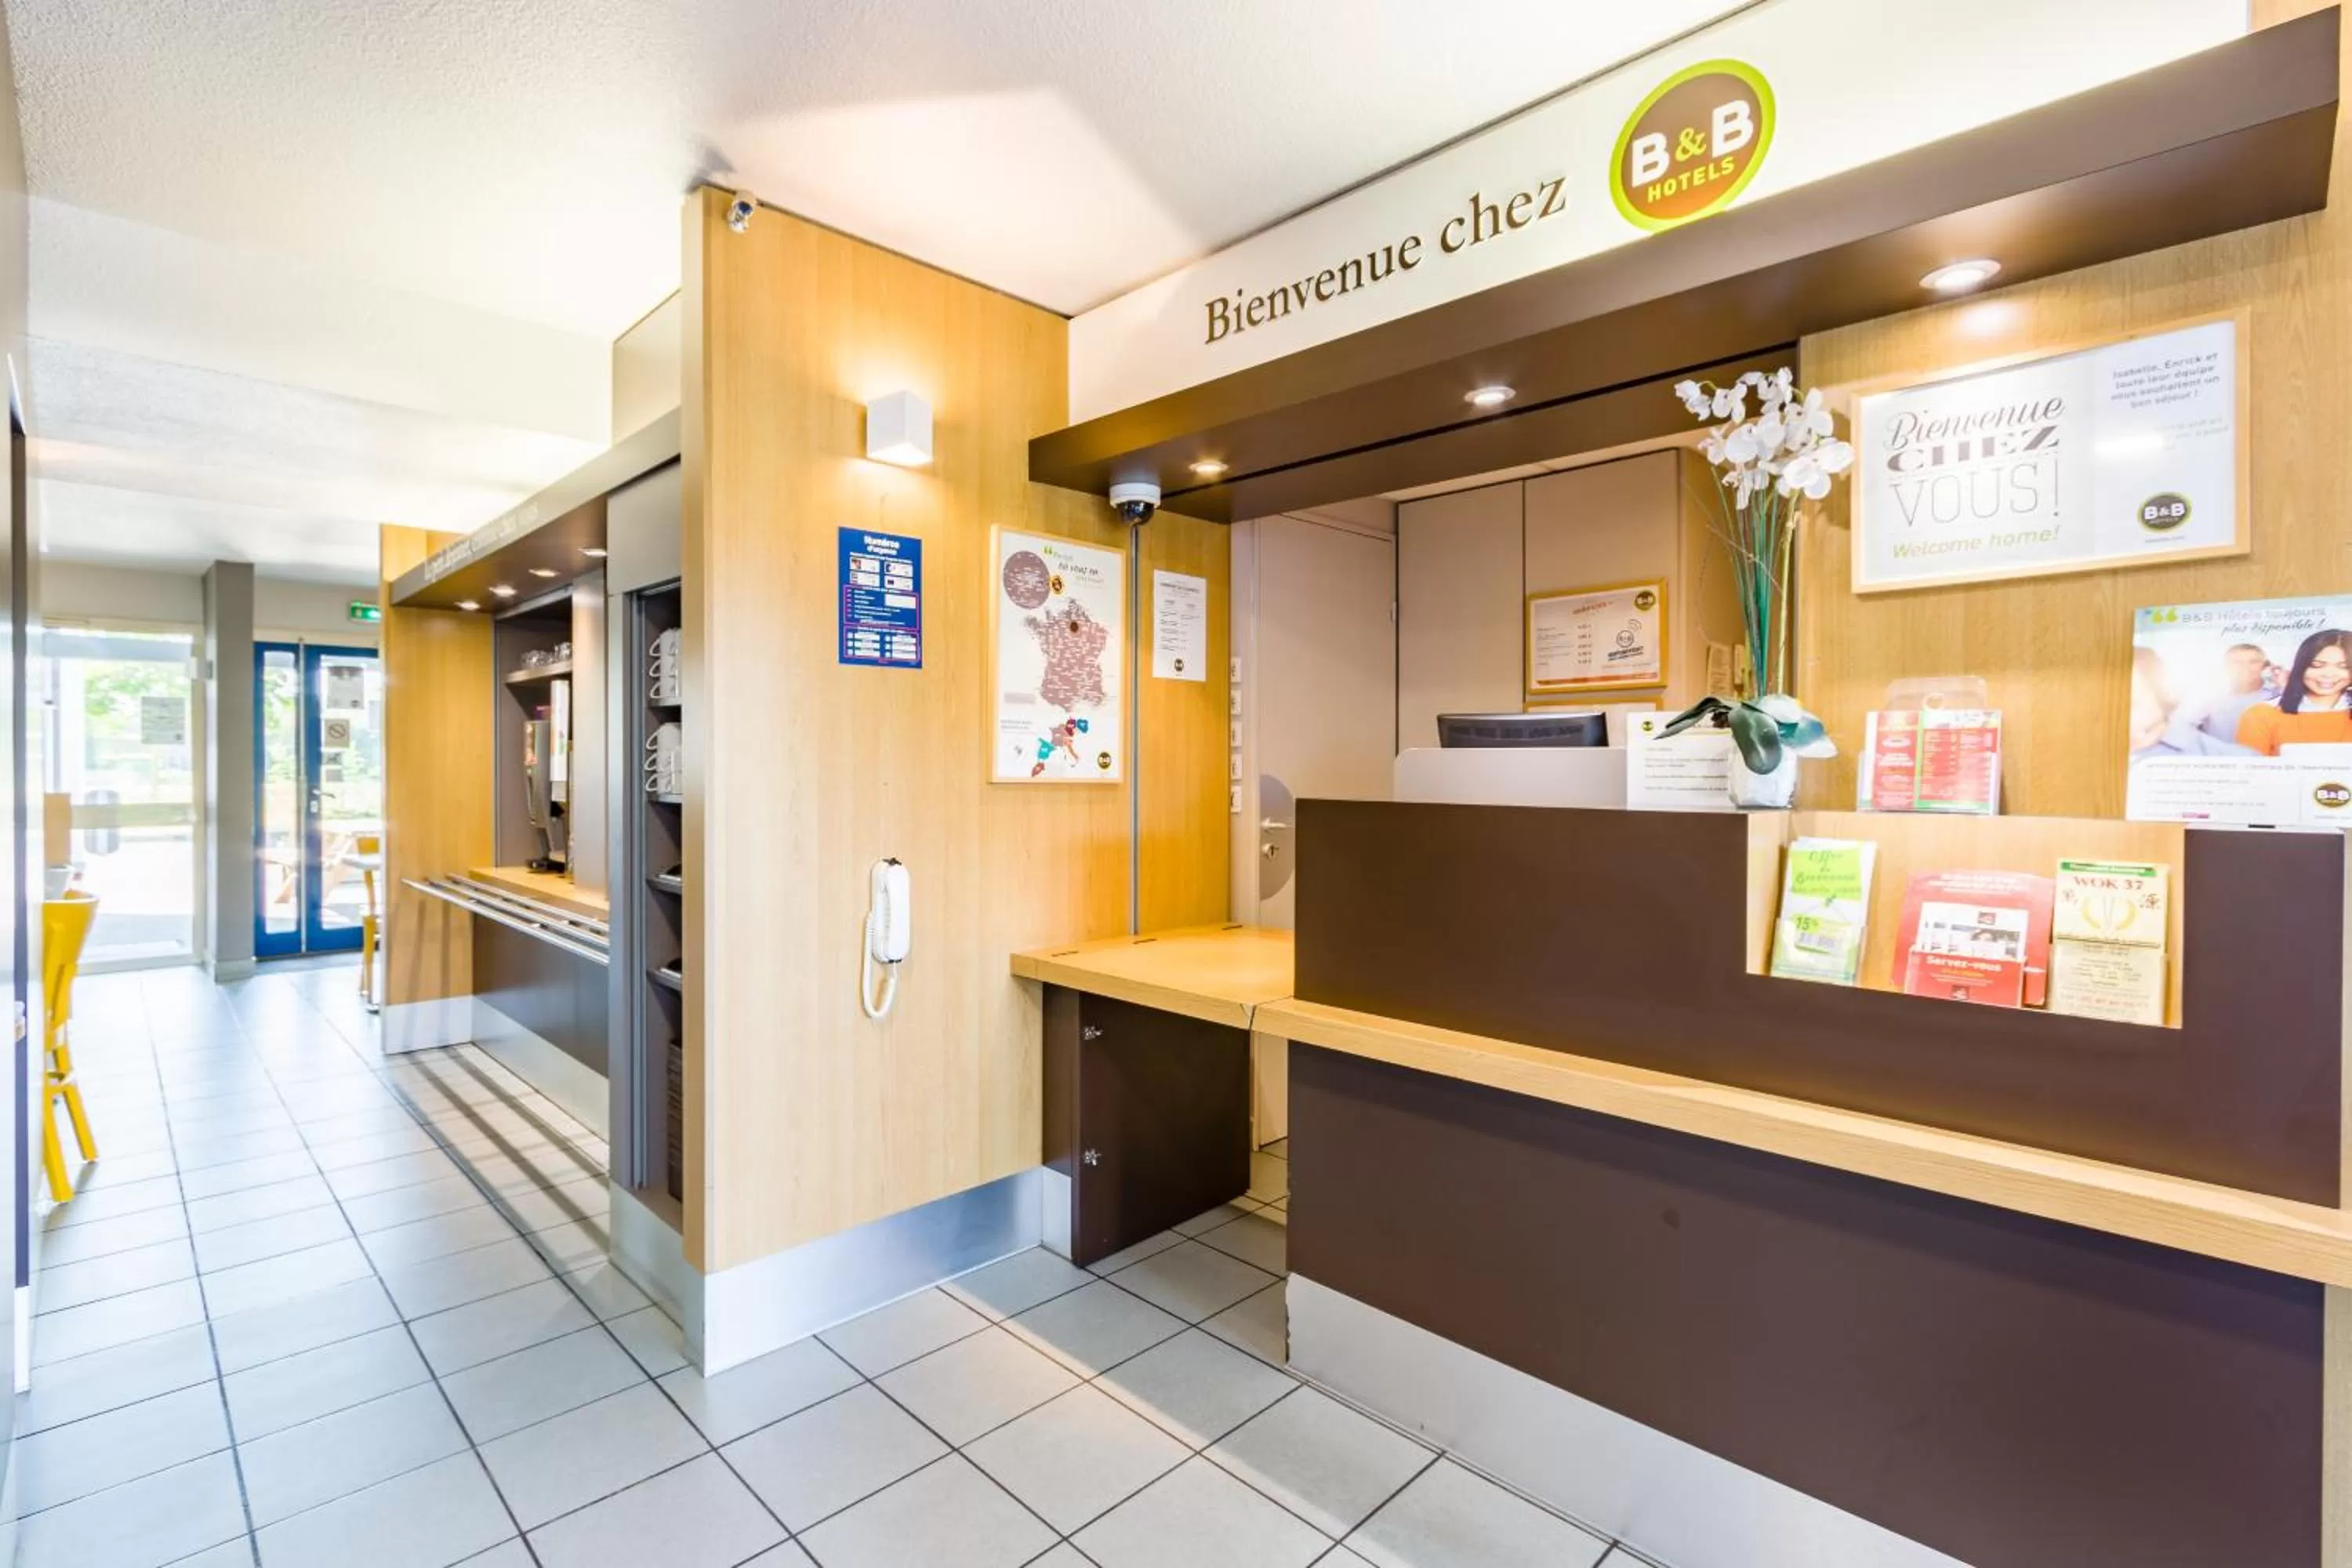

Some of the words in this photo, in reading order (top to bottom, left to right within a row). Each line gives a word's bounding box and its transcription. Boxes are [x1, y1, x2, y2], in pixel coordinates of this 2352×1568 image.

[1632, 100, 1754, 188] B&B
[1647, 156, 1735, 203] HOTELS
[1204, 234, 1422, 345] Bienvenue
[1439, 176, 1567, 254] chez
[1884, 397, 2065, 450] Bienvenue
[1886, 424, 2060, 472] CHEZ
[1888, 456, 2060, 528] VOUS!
[1892, 537, 1983, 559] Welcome
[1990, 524, 2060, 547] home!
[2072, 875, 2118, 890] WOK
[2124, 879, 2144, 890] 37
[1926, 955, 2002, 972] Servez-vous
